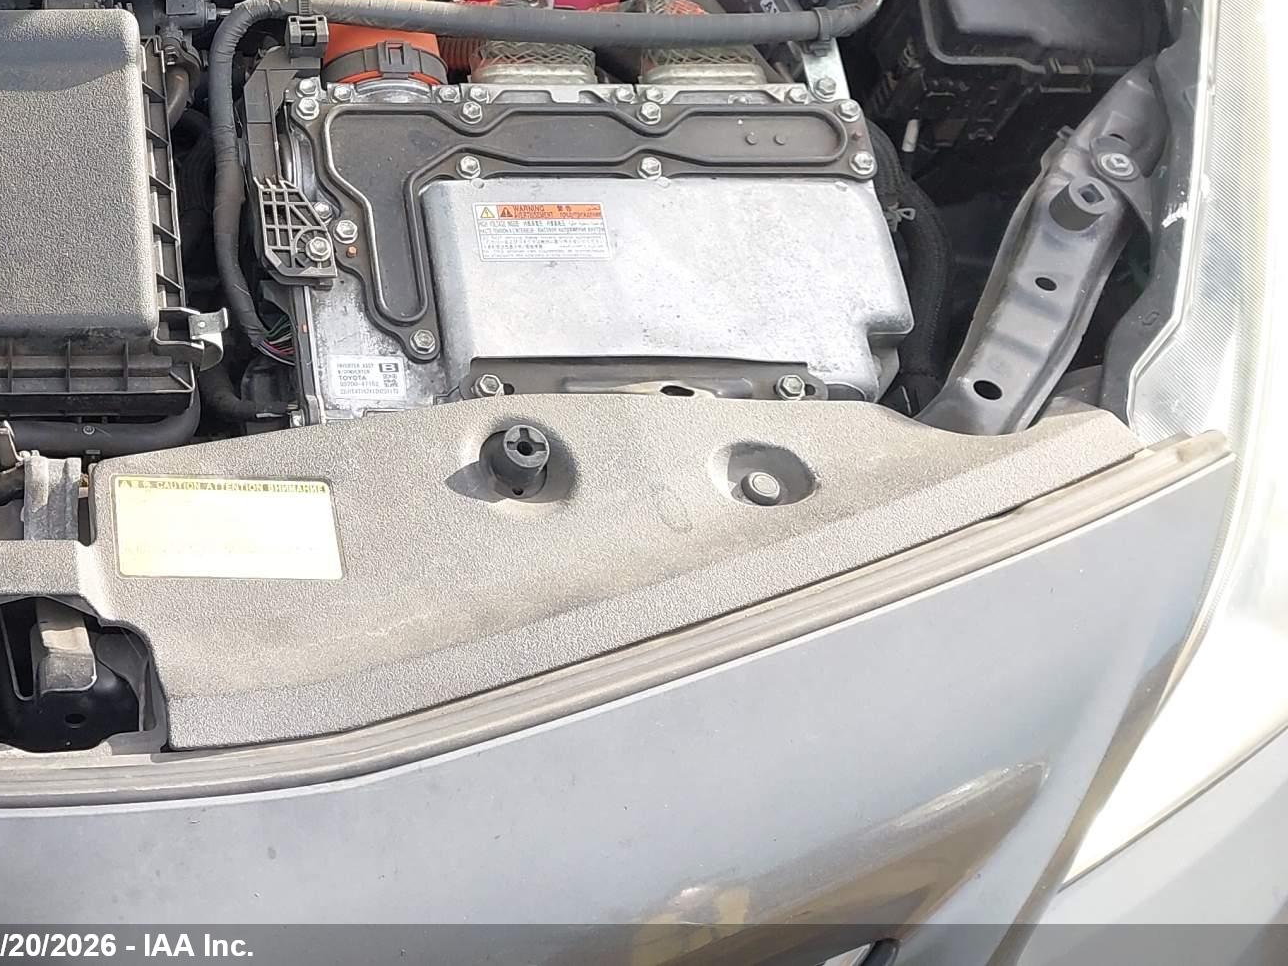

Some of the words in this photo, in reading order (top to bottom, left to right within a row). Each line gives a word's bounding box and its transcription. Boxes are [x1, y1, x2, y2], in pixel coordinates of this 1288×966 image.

[512, 204, 545, 212] WARNING
[382, 364, 396, 372] B
[156, 481, 201, 491] CAUTION
[206, 482, 263, 492] ATTENTION
